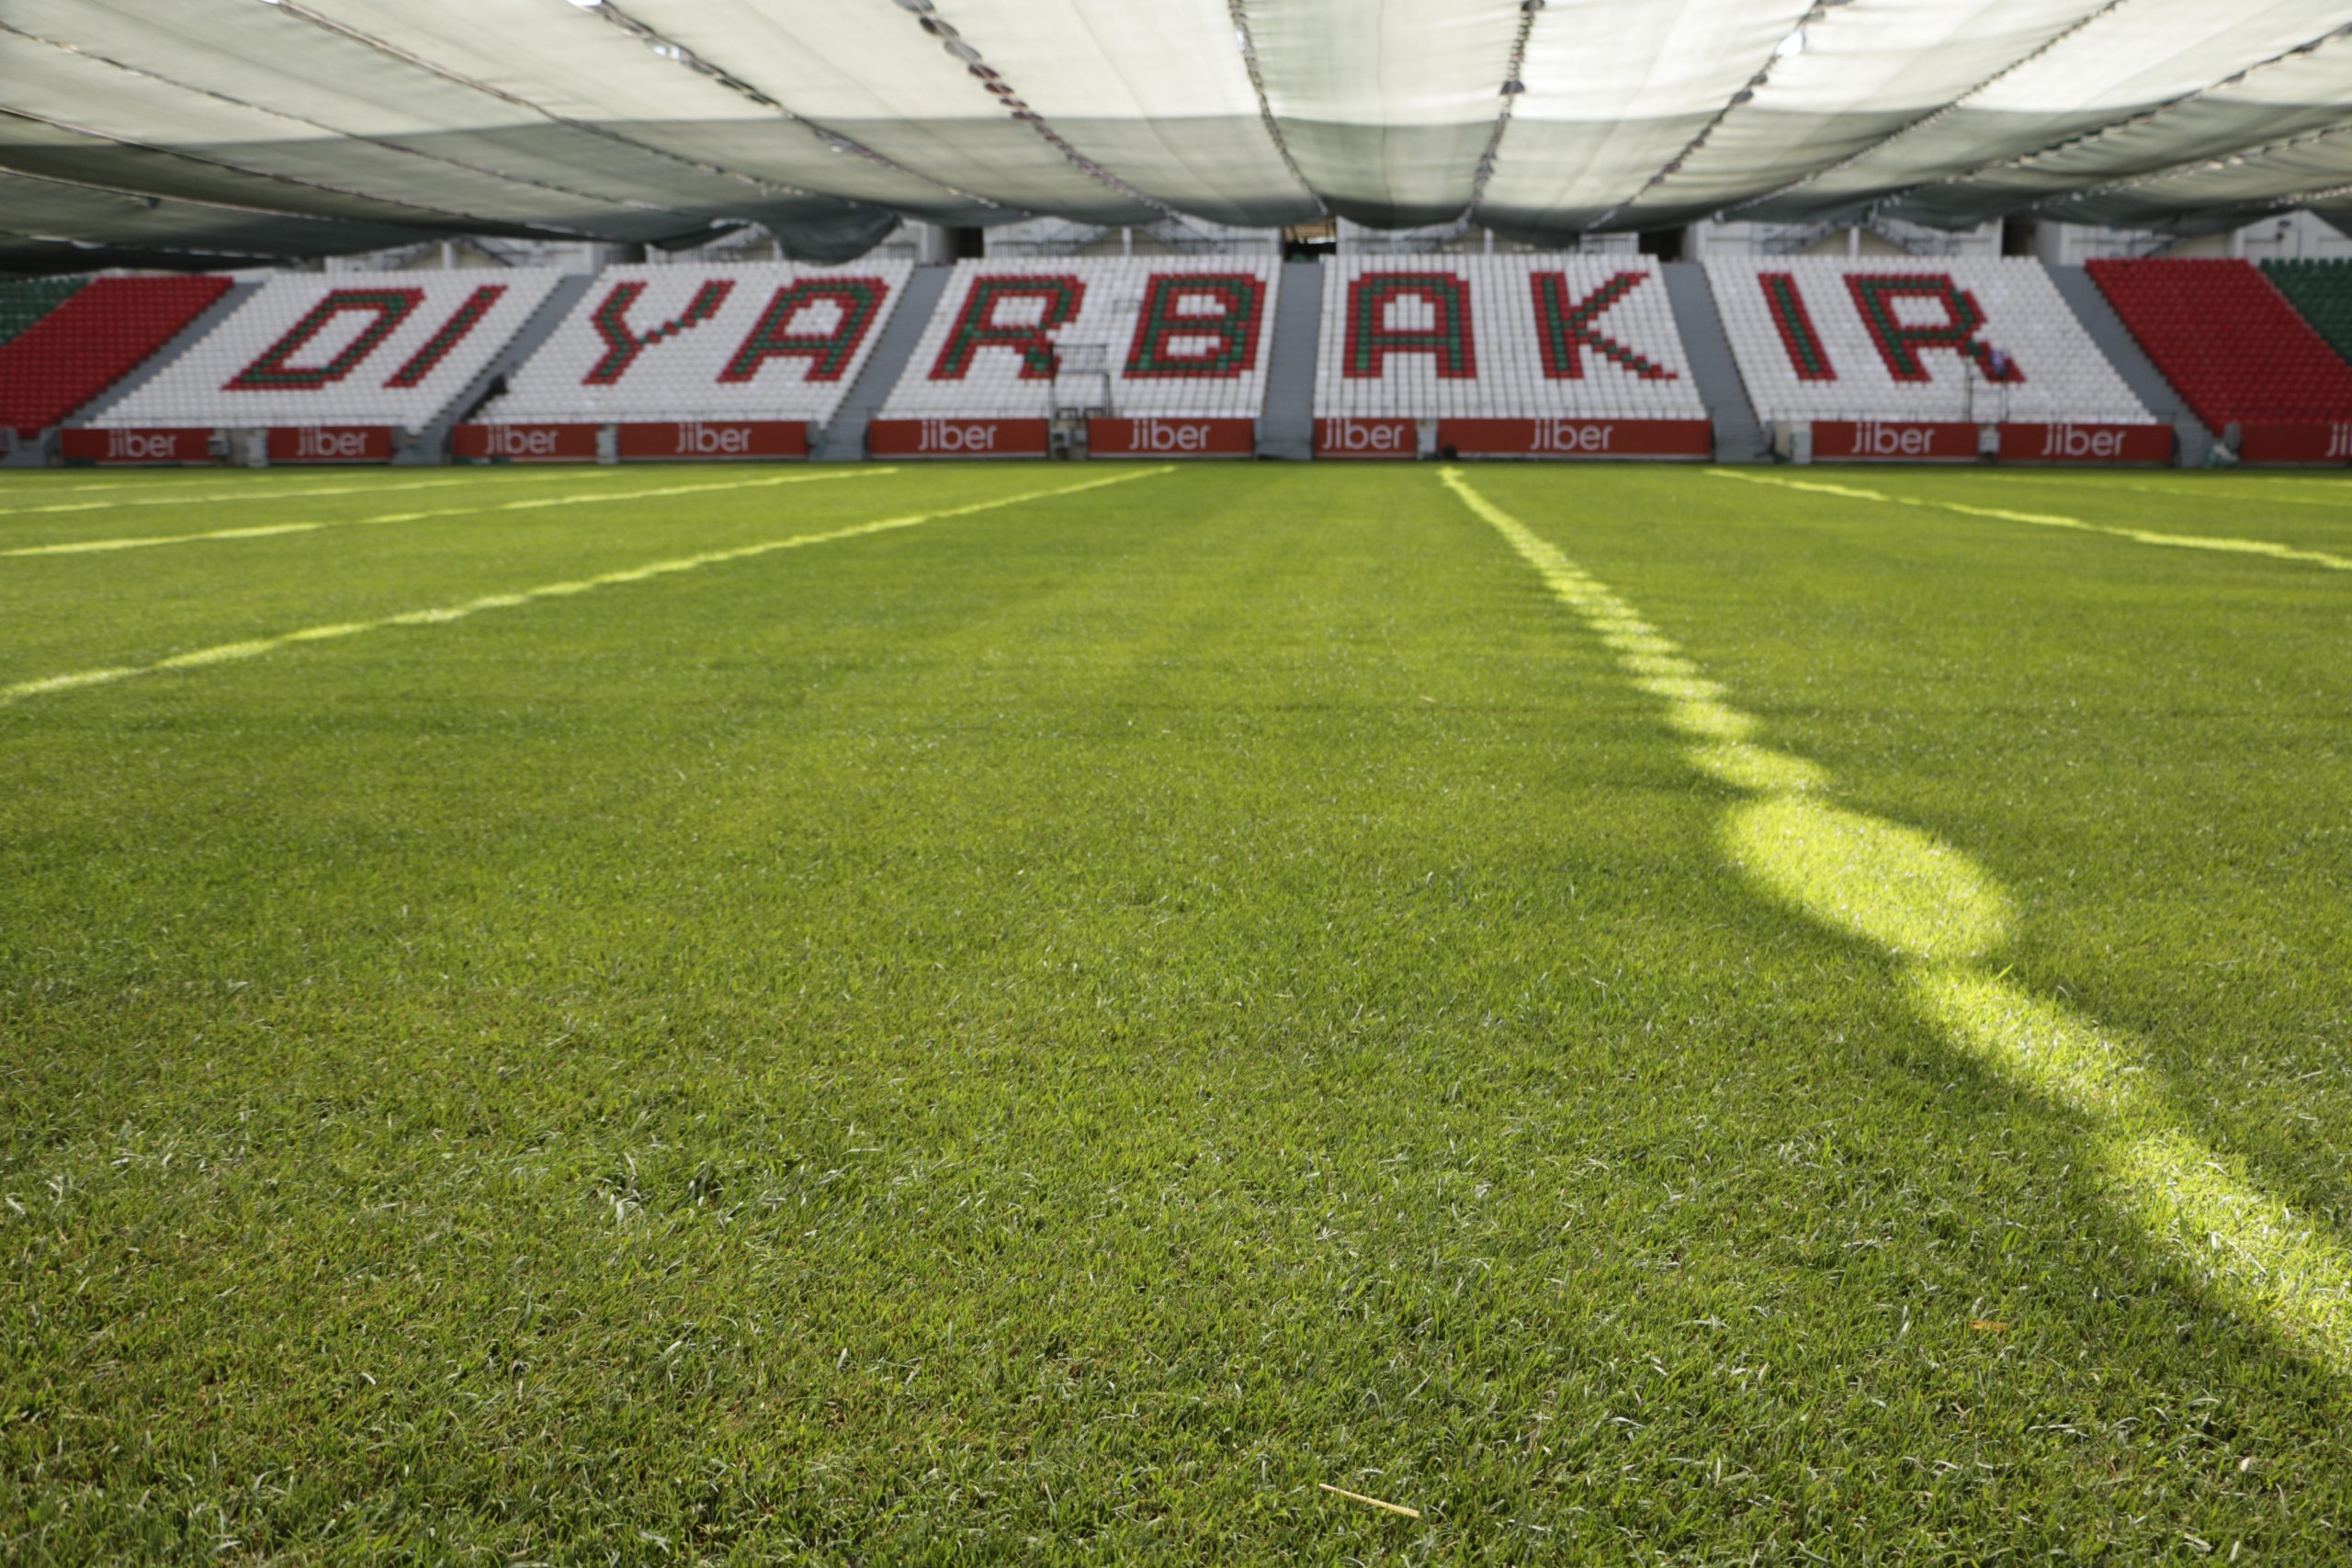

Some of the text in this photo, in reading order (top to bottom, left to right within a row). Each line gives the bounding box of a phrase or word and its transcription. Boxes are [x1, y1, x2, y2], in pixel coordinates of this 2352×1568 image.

[220, 273, 2026, 389] DIYARBAKIR
[107, 430, 176, 457] jiber
[297, 427, 368, 456] jiber
[486, 423, 558, 454] jiber
[675, 422, 752, 453] jiber
[918, 420, 997, 451] jiber
[1129, 420, 1210, 450] jiber
[1322, 419, 1403, 450] jiber
[1531, 419, 1612, 450] jiber
[1851, 422, 1934, 454] jiber
[2041, 424, 2126, 457] jiber
